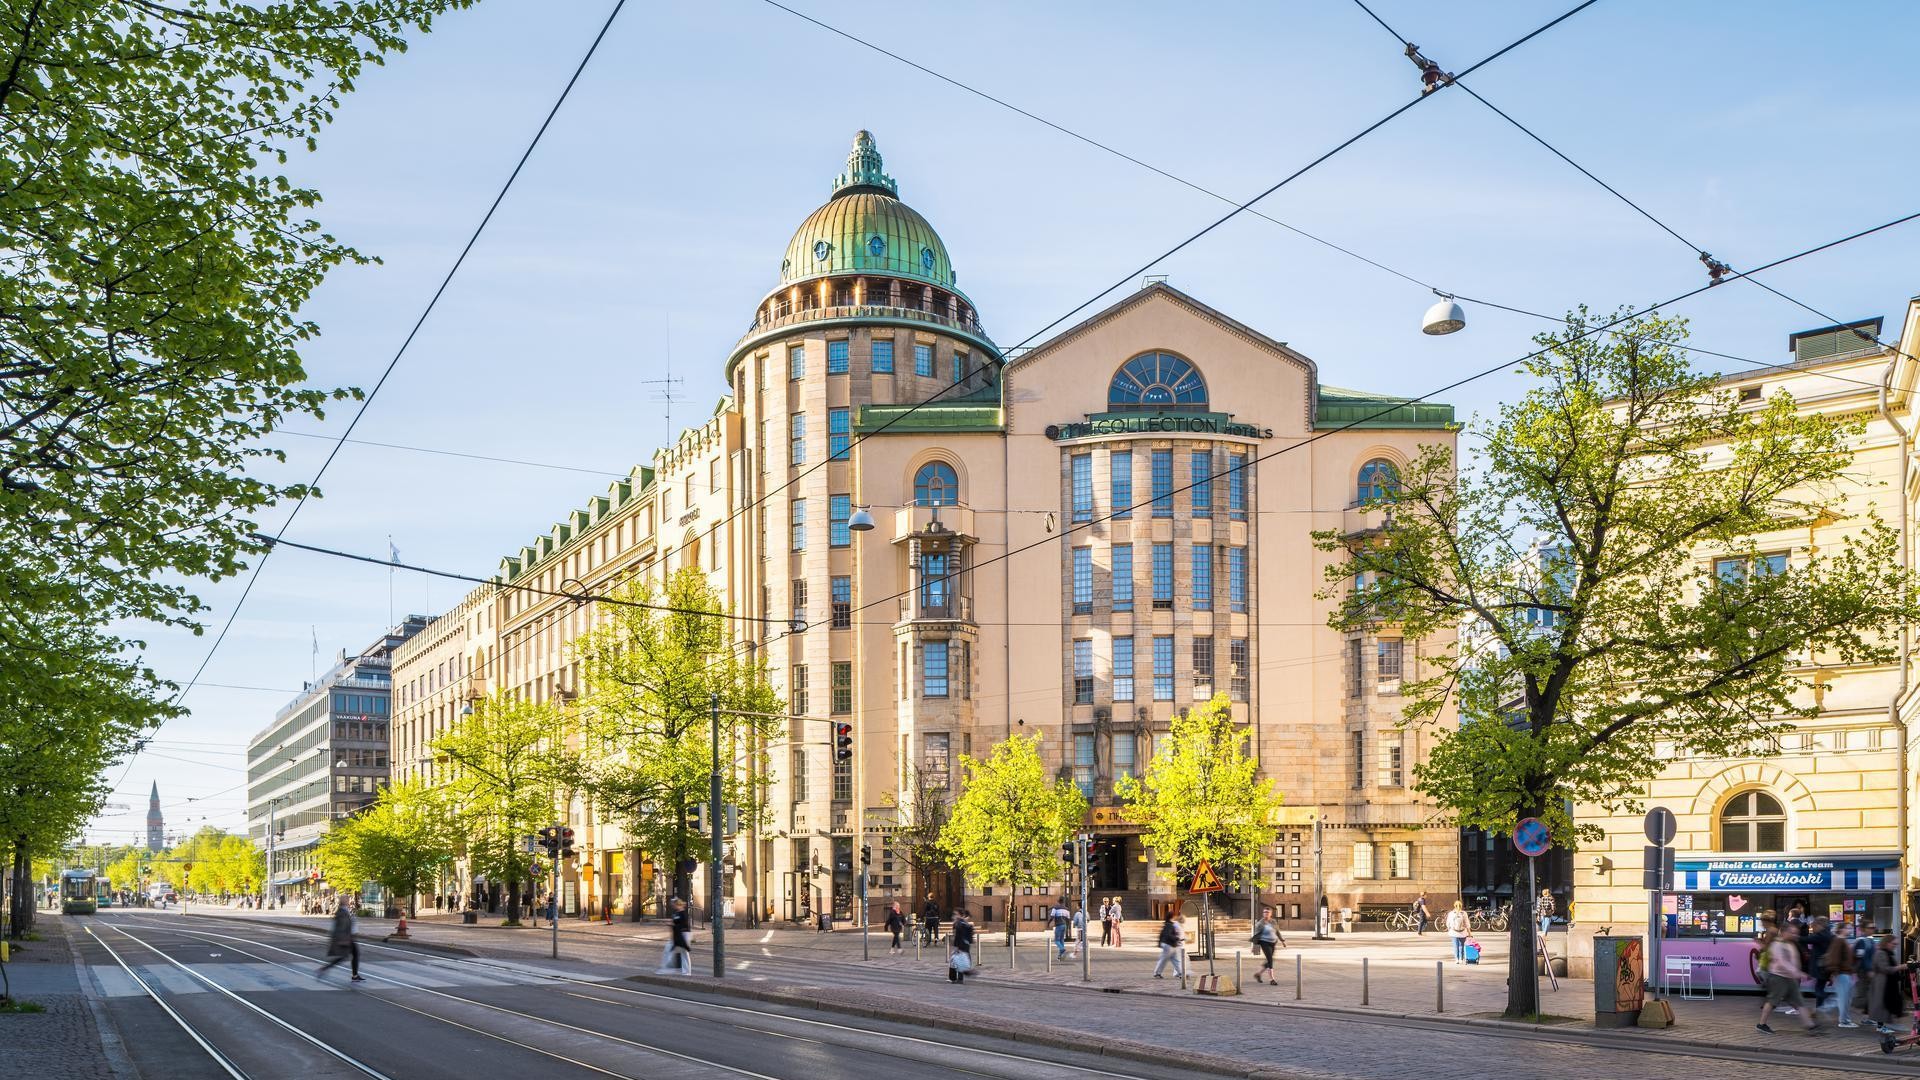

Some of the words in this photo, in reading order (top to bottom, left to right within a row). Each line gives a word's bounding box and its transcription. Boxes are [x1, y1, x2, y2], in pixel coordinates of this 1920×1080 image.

[1097, 417, 1217, 434] COLLECTION
[1224, 425, 1273, 439] HOTELS
[1707, 861, 1743, 871] Jäätelö
[1751, 861, 1777, 869] Glass
[1785, 861, 1800, 869] Ice
[1801, 861, 1834, 869] Cream
[1718, 872, 1824, 887] Jäätelökioski
